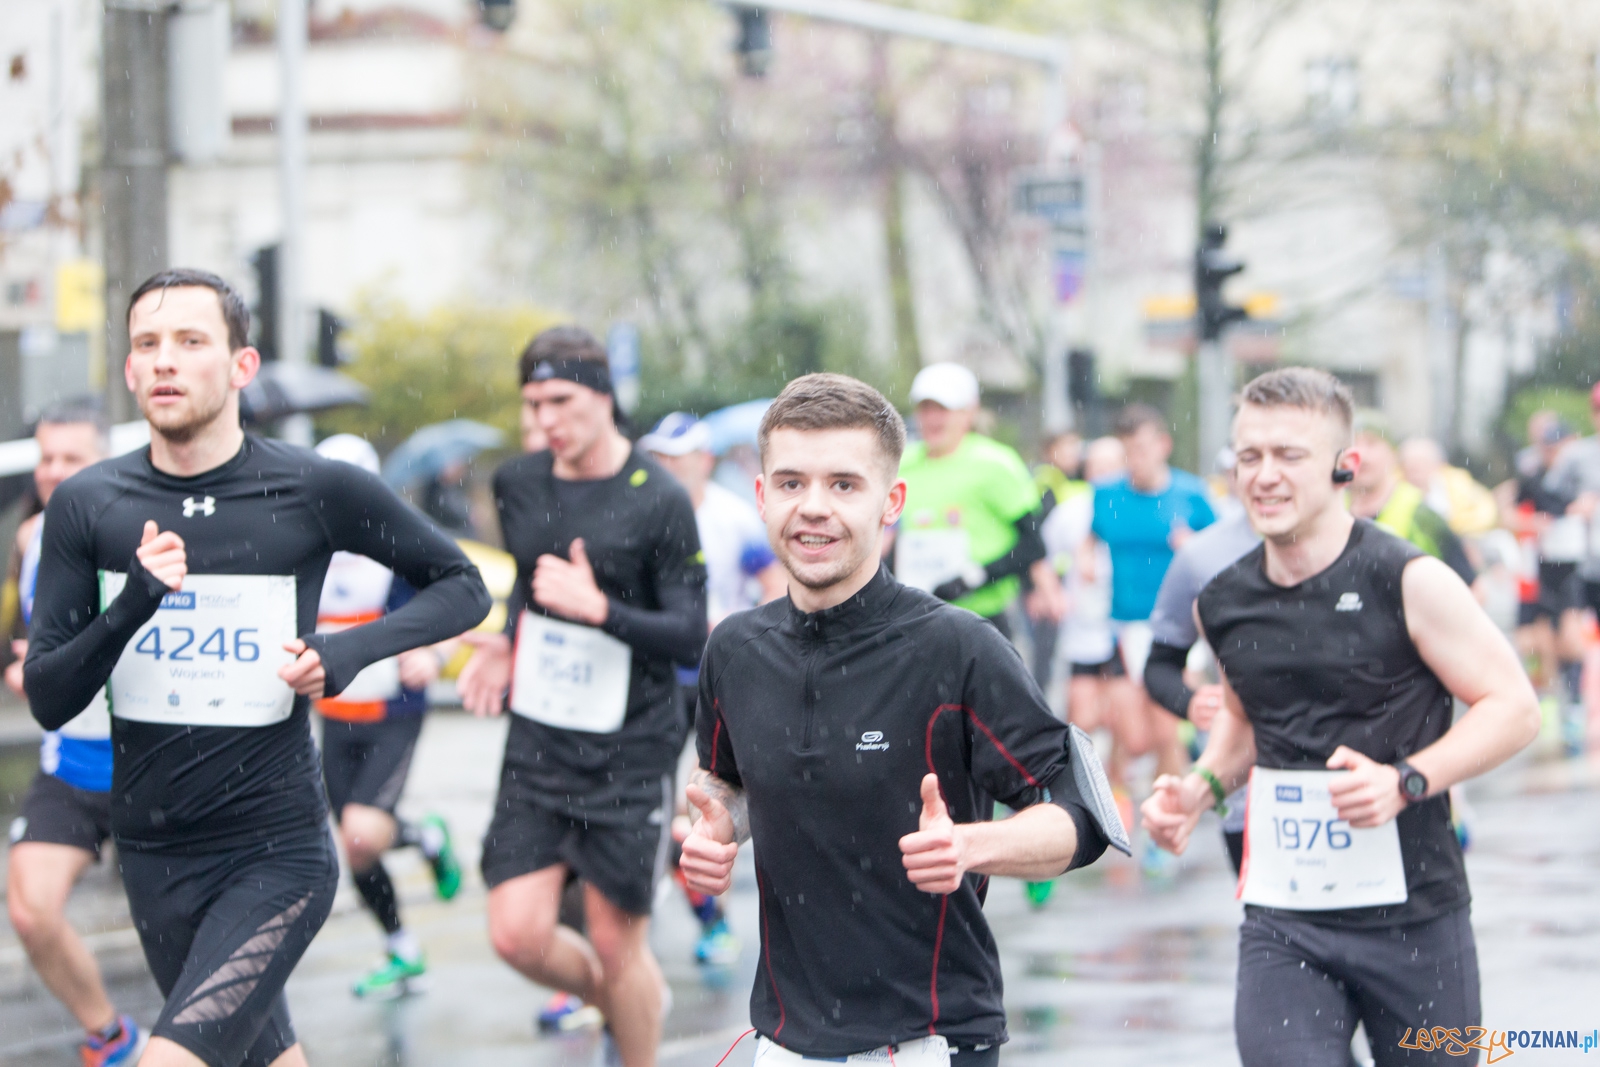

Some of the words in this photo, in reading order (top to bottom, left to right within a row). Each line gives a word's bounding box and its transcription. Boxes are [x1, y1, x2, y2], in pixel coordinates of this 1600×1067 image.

[135, 626, 260, 662] 4246
[169, 667, 225, 680] Wojciech
[1273, 817, 1352, 850] 1976
